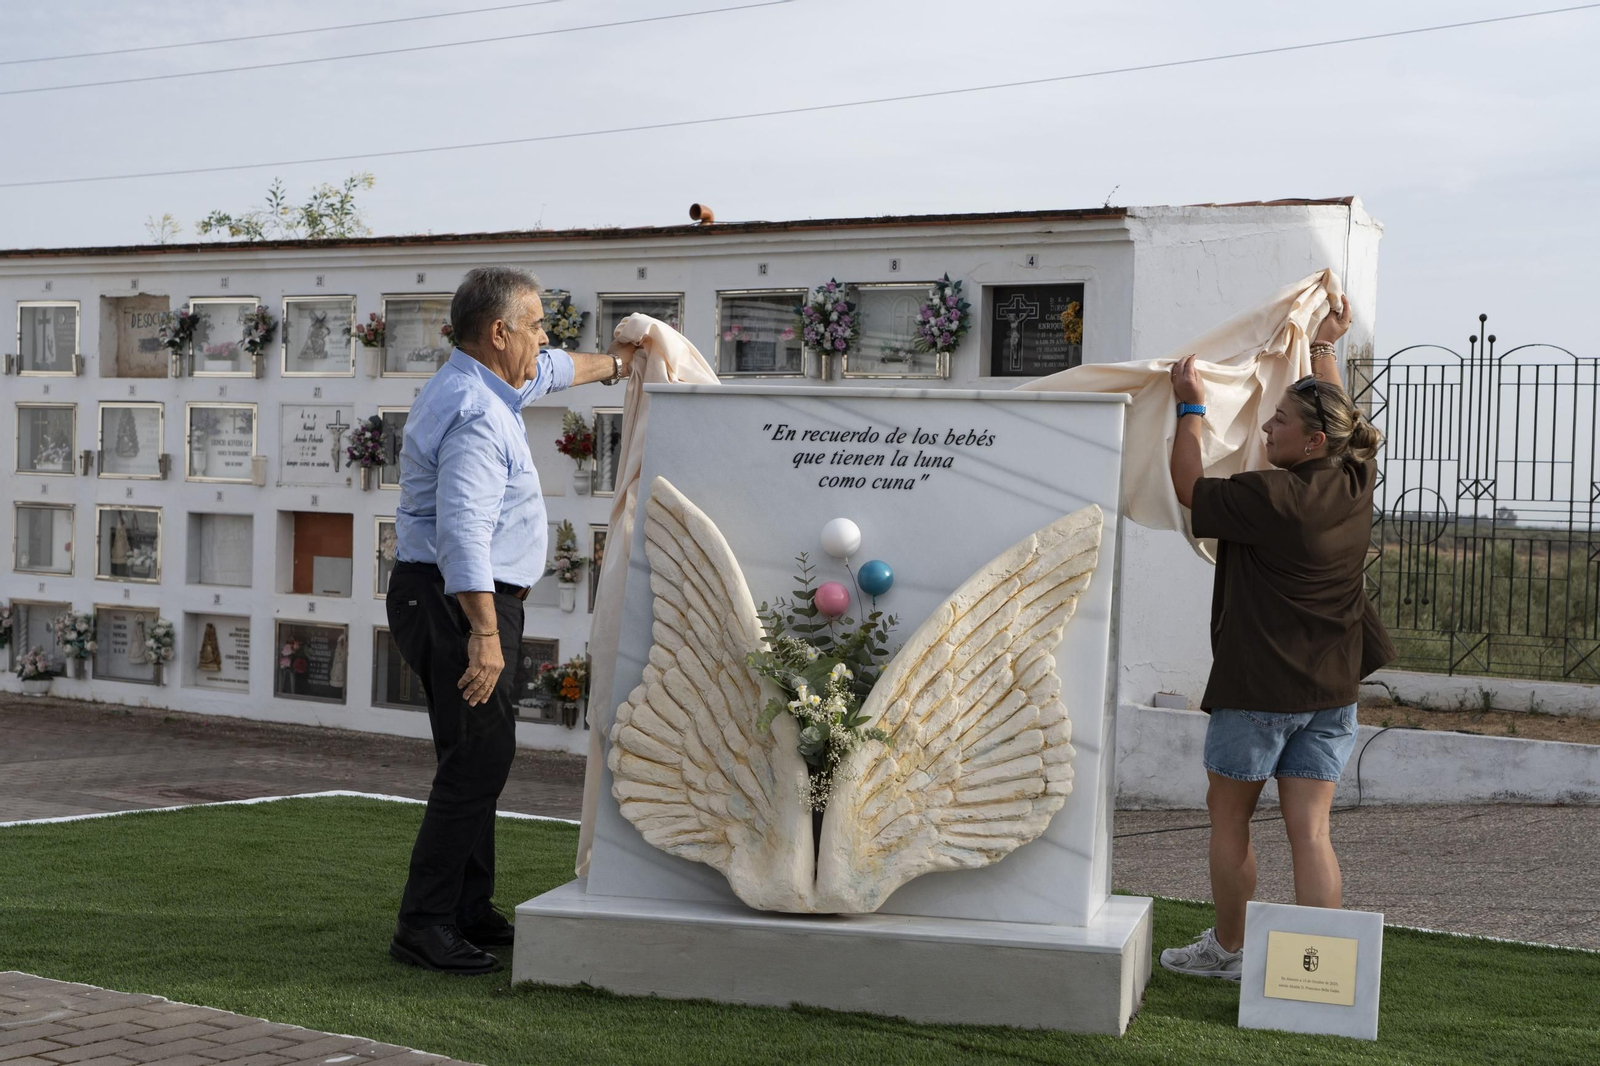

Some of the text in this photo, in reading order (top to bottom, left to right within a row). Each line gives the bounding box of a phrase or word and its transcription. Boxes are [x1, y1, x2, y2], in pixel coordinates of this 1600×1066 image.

[892, 260, 897, 270] 8
[1028, 256, 1034, 266] 4
[760, 264, 766, 274] 12
[801, 426, 880, 444] recuerdo
[885, 427, 907, 445] de
[912, 428, 939, 446] los
[944, 428, 996, 447] bebés
[792, 450, 954, 469] que tienen la luna
[818, 475, 866, 489] como
